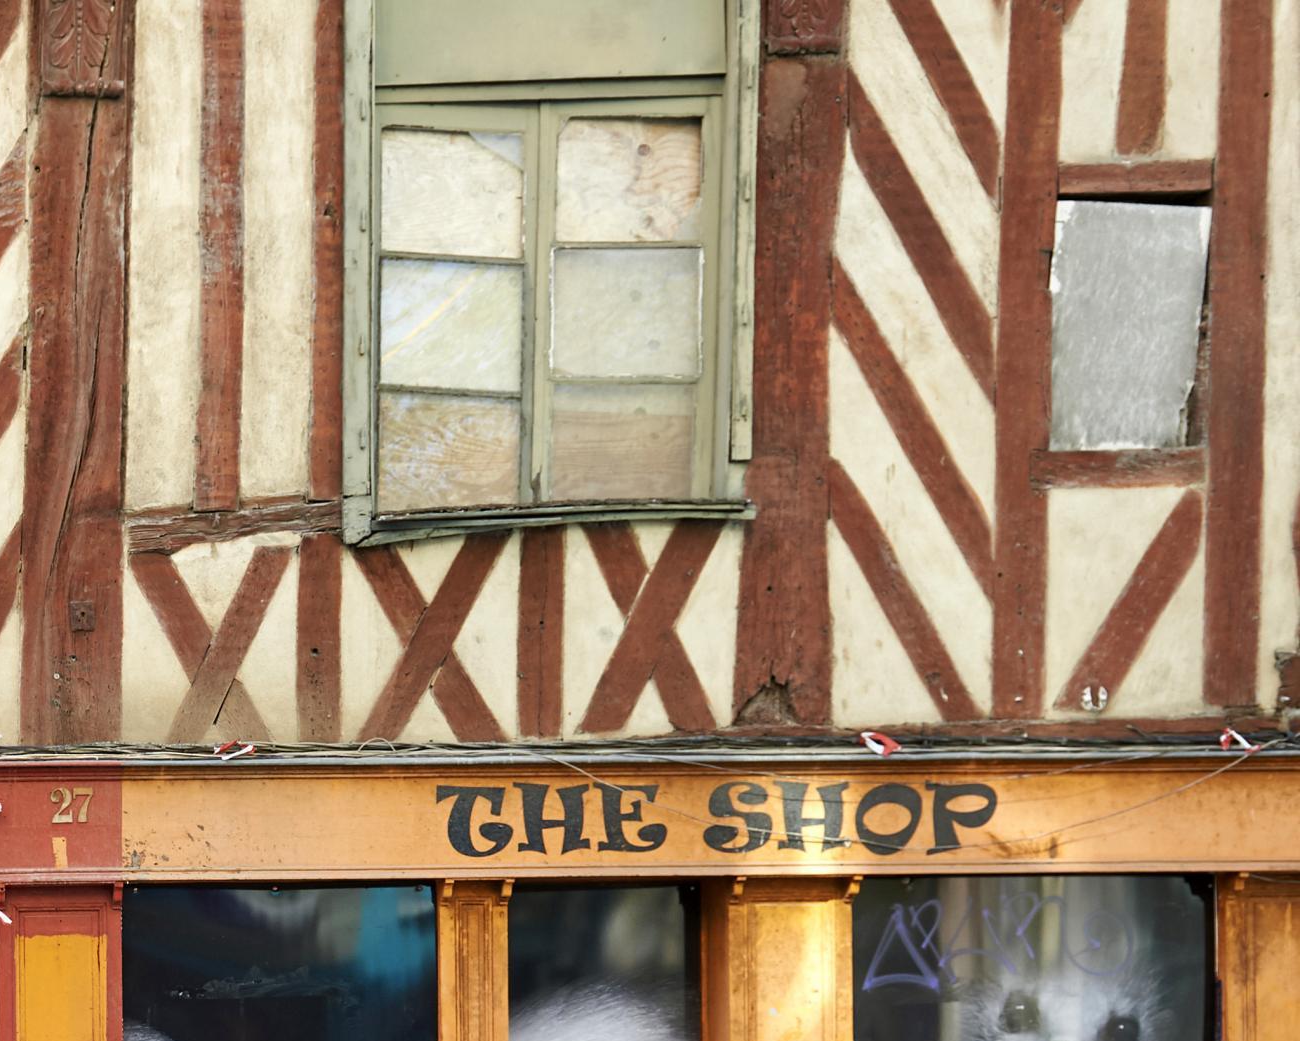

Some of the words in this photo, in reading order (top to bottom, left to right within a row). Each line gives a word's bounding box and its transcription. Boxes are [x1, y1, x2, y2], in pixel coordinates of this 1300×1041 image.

[50, 787, 93, 824] 27
[437, 781, 668, 857] THE
[703, 781, 998, 857] SHOP
